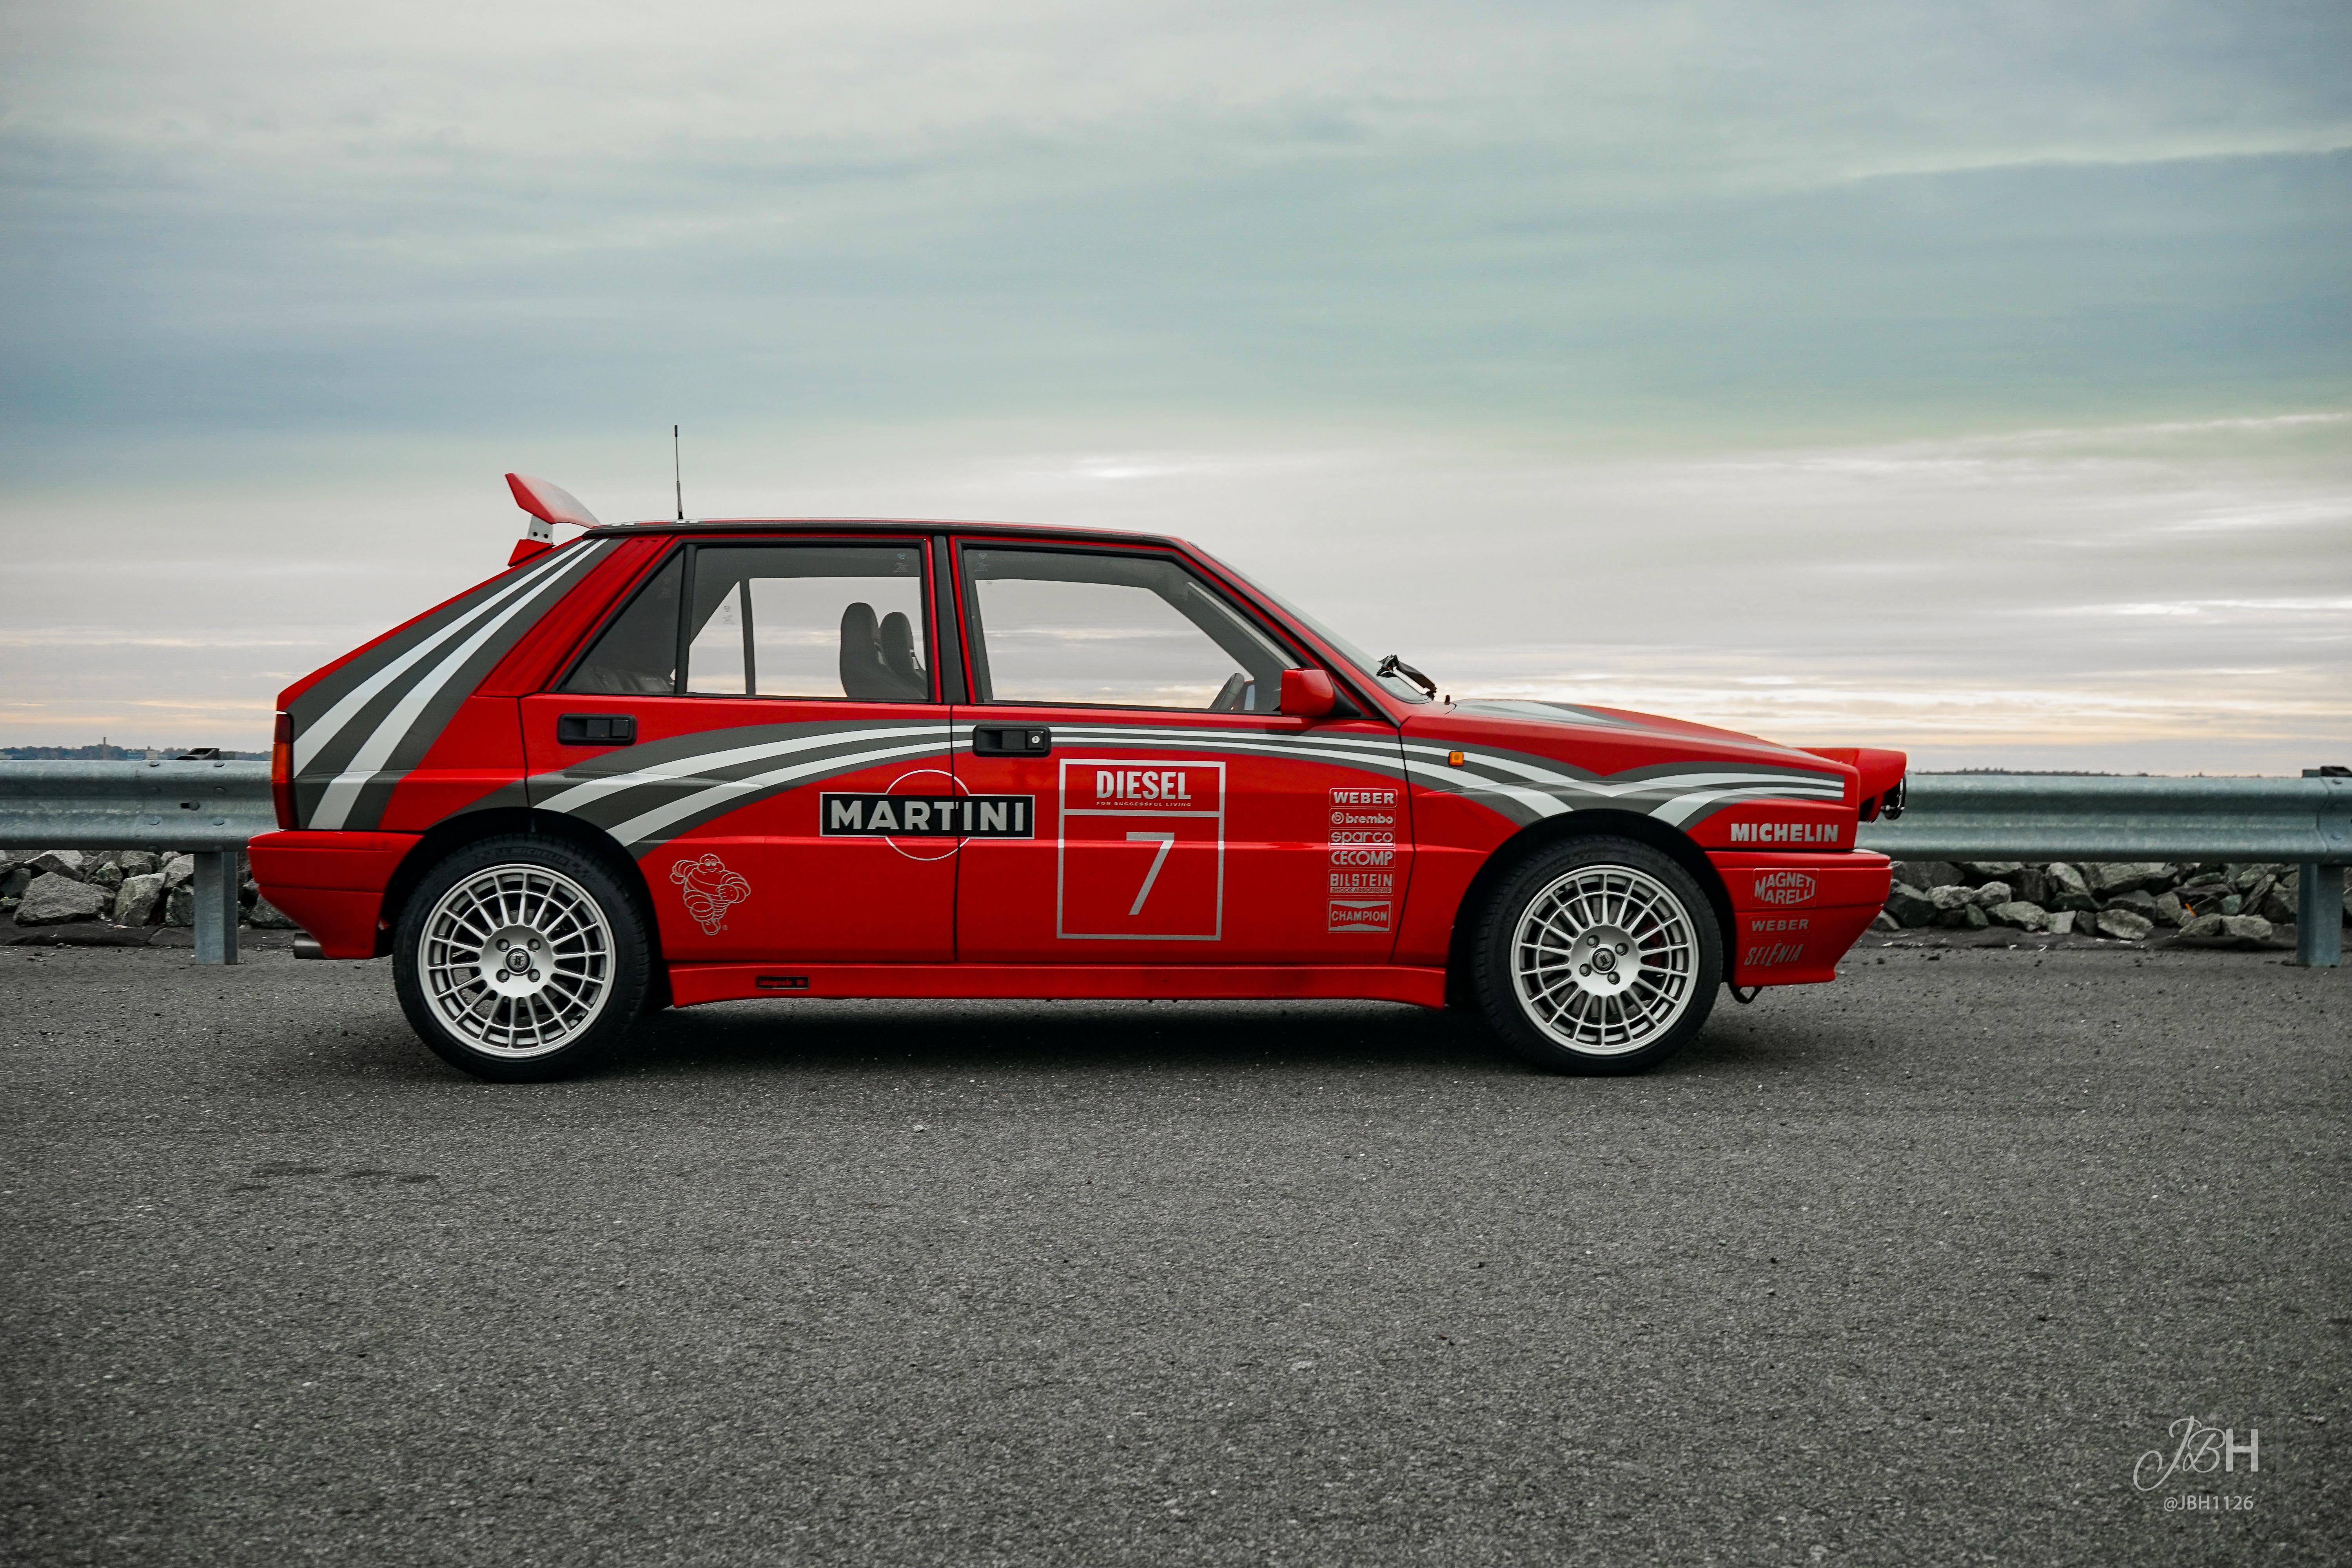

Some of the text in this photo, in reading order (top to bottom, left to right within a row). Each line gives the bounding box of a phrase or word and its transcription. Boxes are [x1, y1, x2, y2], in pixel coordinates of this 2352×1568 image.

[1096, 771, 1192, 800] DIESEL
[1333, 792, 1394, 804] WEBER
[831, 800, 1024, 831] MARTINI
[1345, 812, 1394, 824] brembo
[1330, 831, 1393, 846] sparco
[1731, 823, 1839, 842] MICHELIN
[1331, 850, 1393, 866] CECOMP
[1125, 831, 1175, 915] 7
[1330, 873, 1392, 887] BILSTEIN
[1332, 911, 1387, 921] CHAMPION
[1752, 919, 1809, 931] WEBER
[1744, 943, 1804, 966] SELENIA
